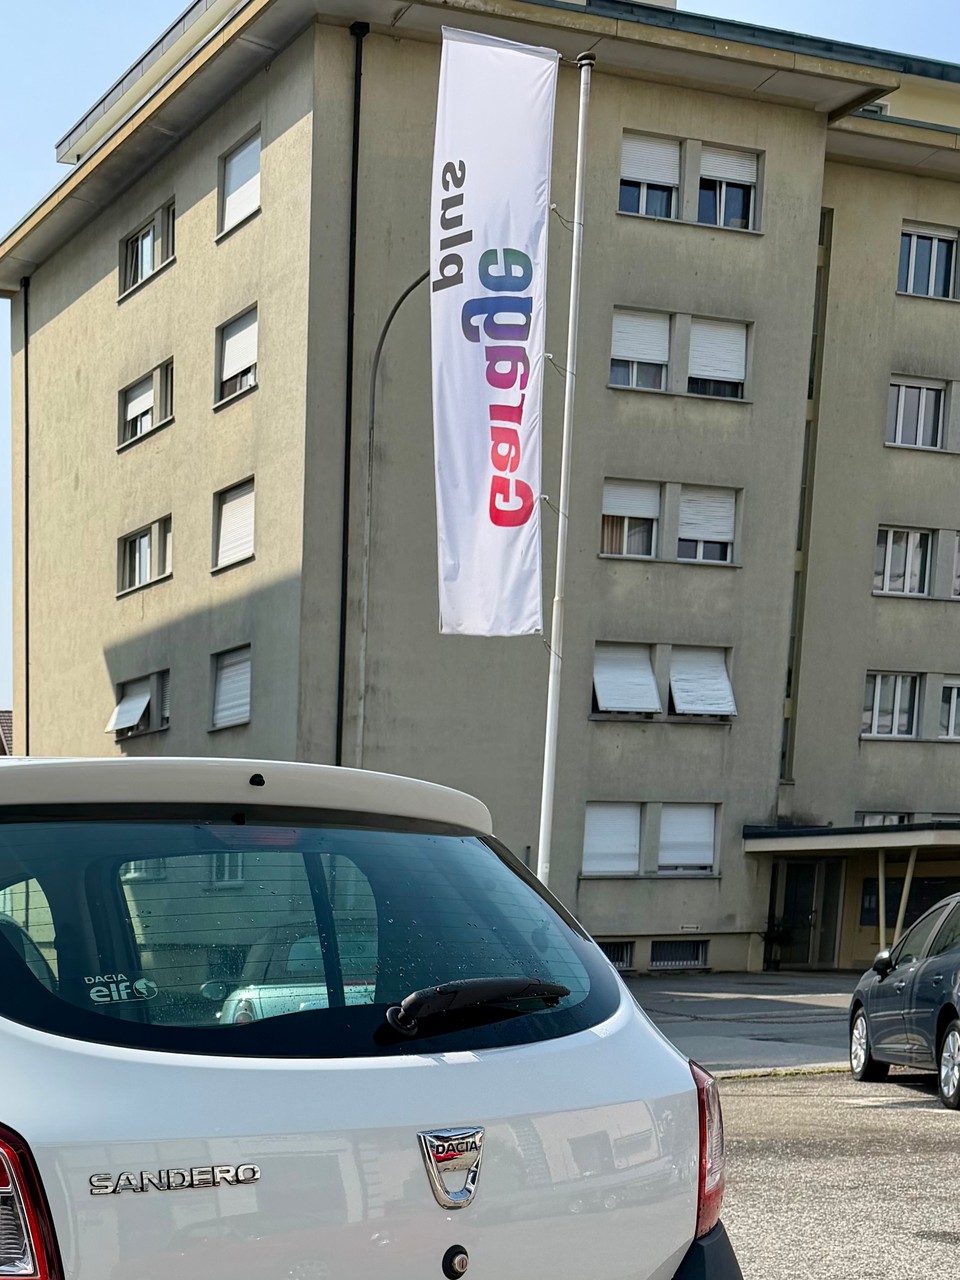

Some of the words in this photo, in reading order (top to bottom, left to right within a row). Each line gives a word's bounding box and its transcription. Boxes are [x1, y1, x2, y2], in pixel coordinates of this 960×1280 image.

[84, 973, 127, 984] DACIA
[89, 982, 131, 1002] elf
[435, 1140, 478, 1155] DACIA
[89, 1163, 262, 1195] SANDERO
